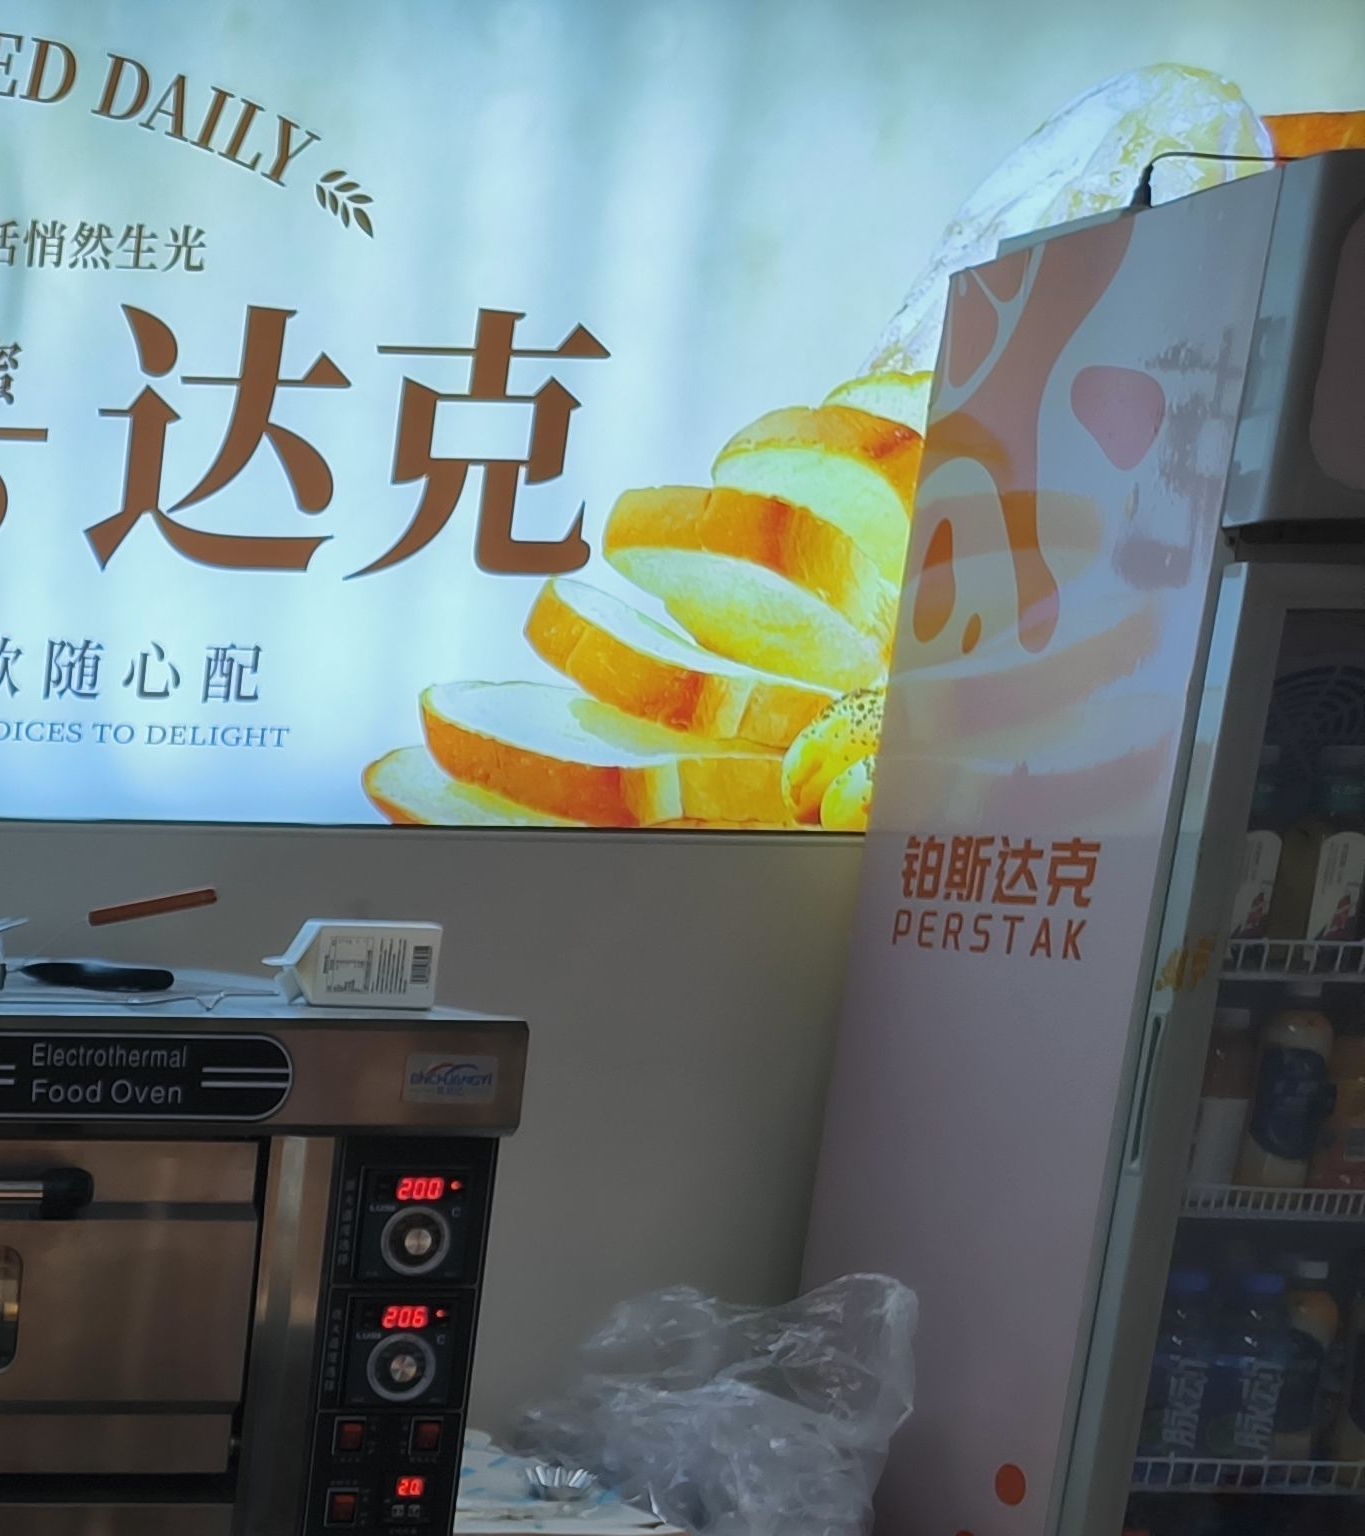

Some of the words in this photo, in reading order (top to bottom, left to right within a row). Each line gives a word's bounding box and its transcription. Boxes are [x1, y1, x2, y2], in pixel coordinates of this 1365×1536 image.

[91, 55, 322, 190] DAILY
[84, 302, 611, 581] 达克
[92, 721, 138, 747] TO
[145, 722, 291, 751] DELIGHT
[900, 834, 1101, 907] 铂斯达克
[892, 909, 1087, 961] PERSTAK
[31, 1043, 188, 1072] Electrothermal
[30, 1077, 104, 1104] Food
[110, 1078, 183, 1104] Oven
[380, 1305, 430, 1329] 206
